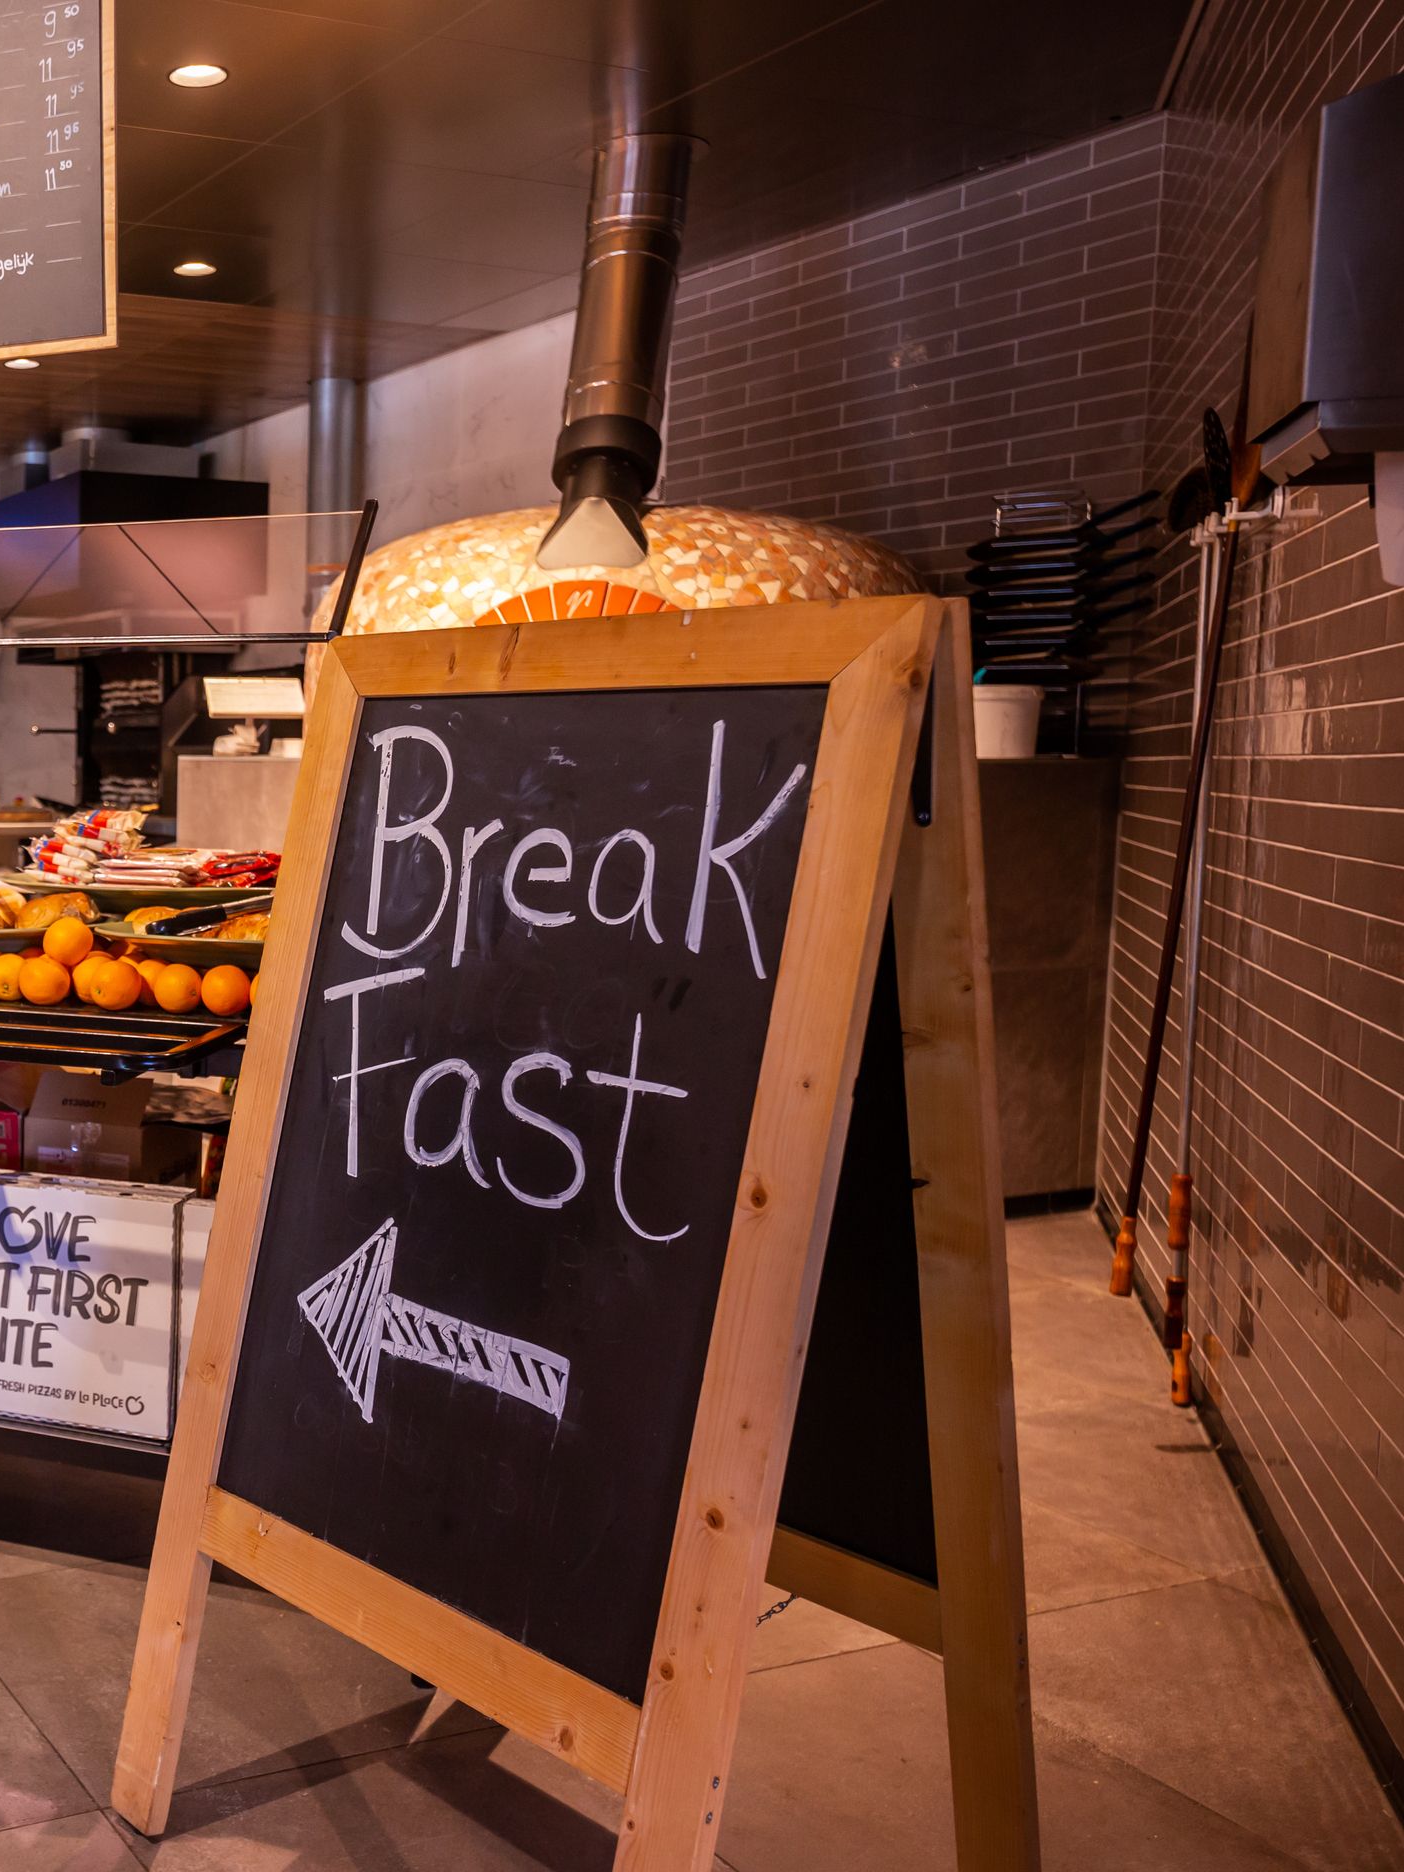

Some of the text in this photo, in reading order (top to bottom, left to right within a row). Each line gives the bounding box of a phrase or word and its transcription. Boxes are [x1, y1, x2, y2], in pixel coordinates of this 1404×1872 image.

[39, 57, 52, 82] 11
[46, 94, 57, 117] 11
[47, 129, 59, 153] 11
[45, 168, 57, 190] 11
[341, 719, 807, 980] Break
[323, 966, 690, 1242] Fast
[26, 1265, 149, 1327] FIRST
[27, 1383, 62, 1399] PIZZAS
[64, 1389, 77, 1401] BY
